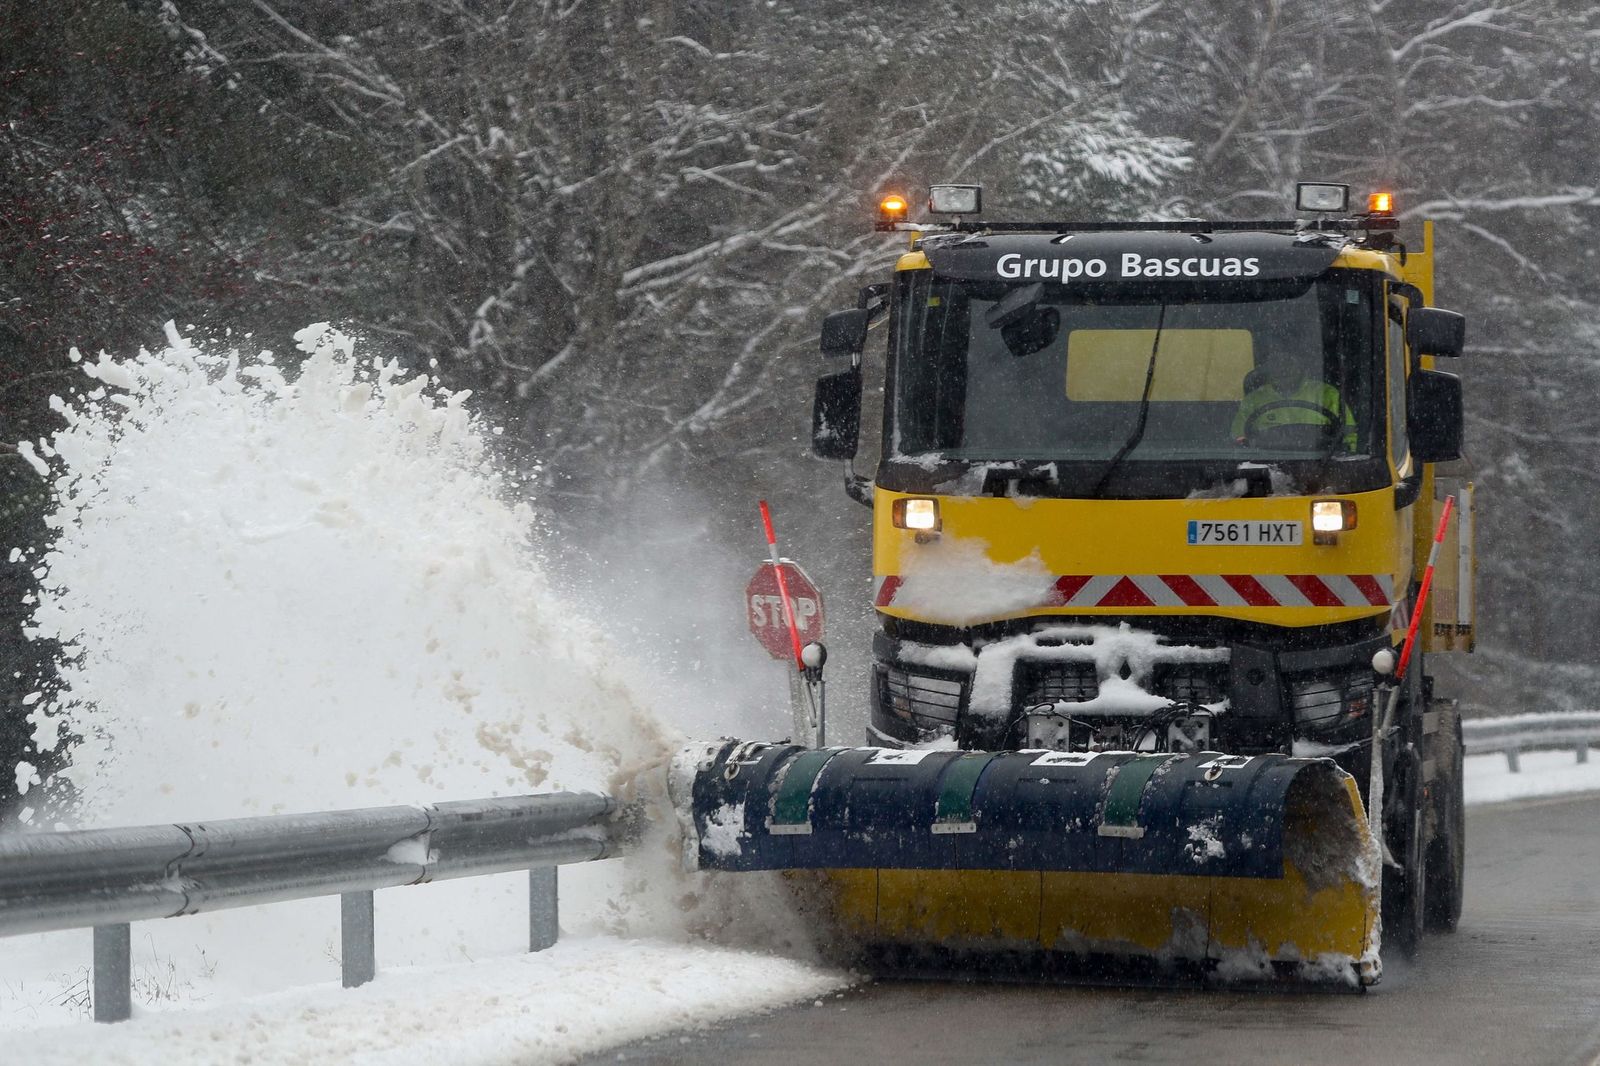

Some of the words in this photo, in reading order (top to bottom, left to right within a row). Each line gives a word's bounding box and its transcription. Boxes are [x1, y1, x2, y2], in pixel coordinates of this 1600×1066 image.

[996, 253, 1107, 284] Grupo
[1121, 253, 1260, 277] Bascuas
[1201, 523, 1249, 541] 7561
[1259, 523, 1297, 541] HXT
